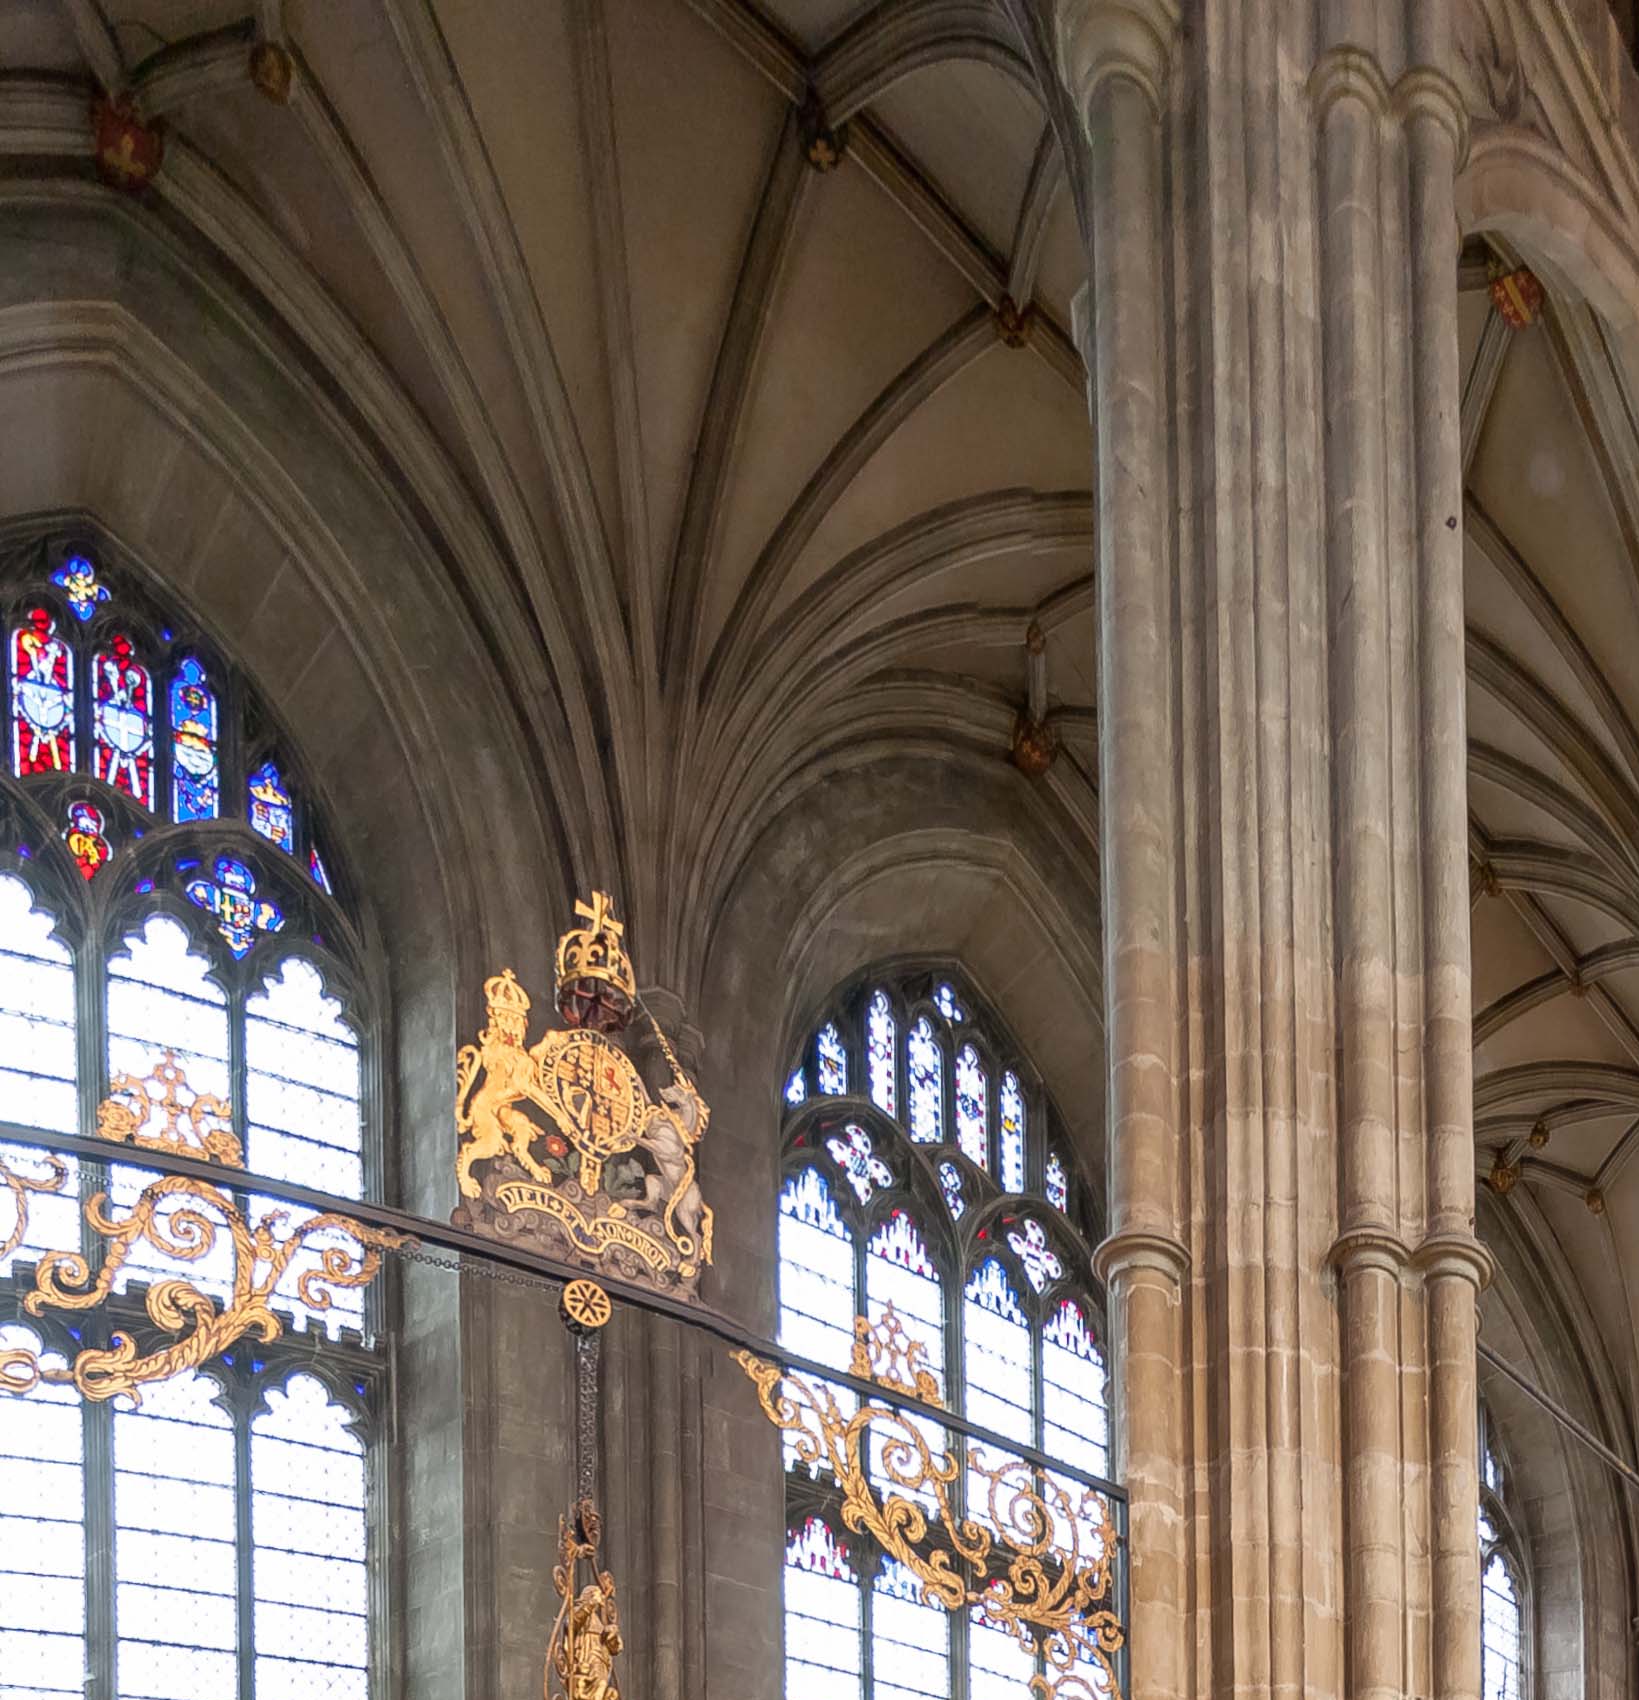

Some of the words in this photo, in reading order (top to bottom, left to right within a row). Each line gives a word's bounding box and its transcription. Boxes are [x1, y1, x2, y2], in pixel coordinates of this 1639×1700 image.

[500, 1187, 550, 1207] DIEU
[560, 1204, 585, 1230] ET
[632, 1233, 669, 1272] DROIT
